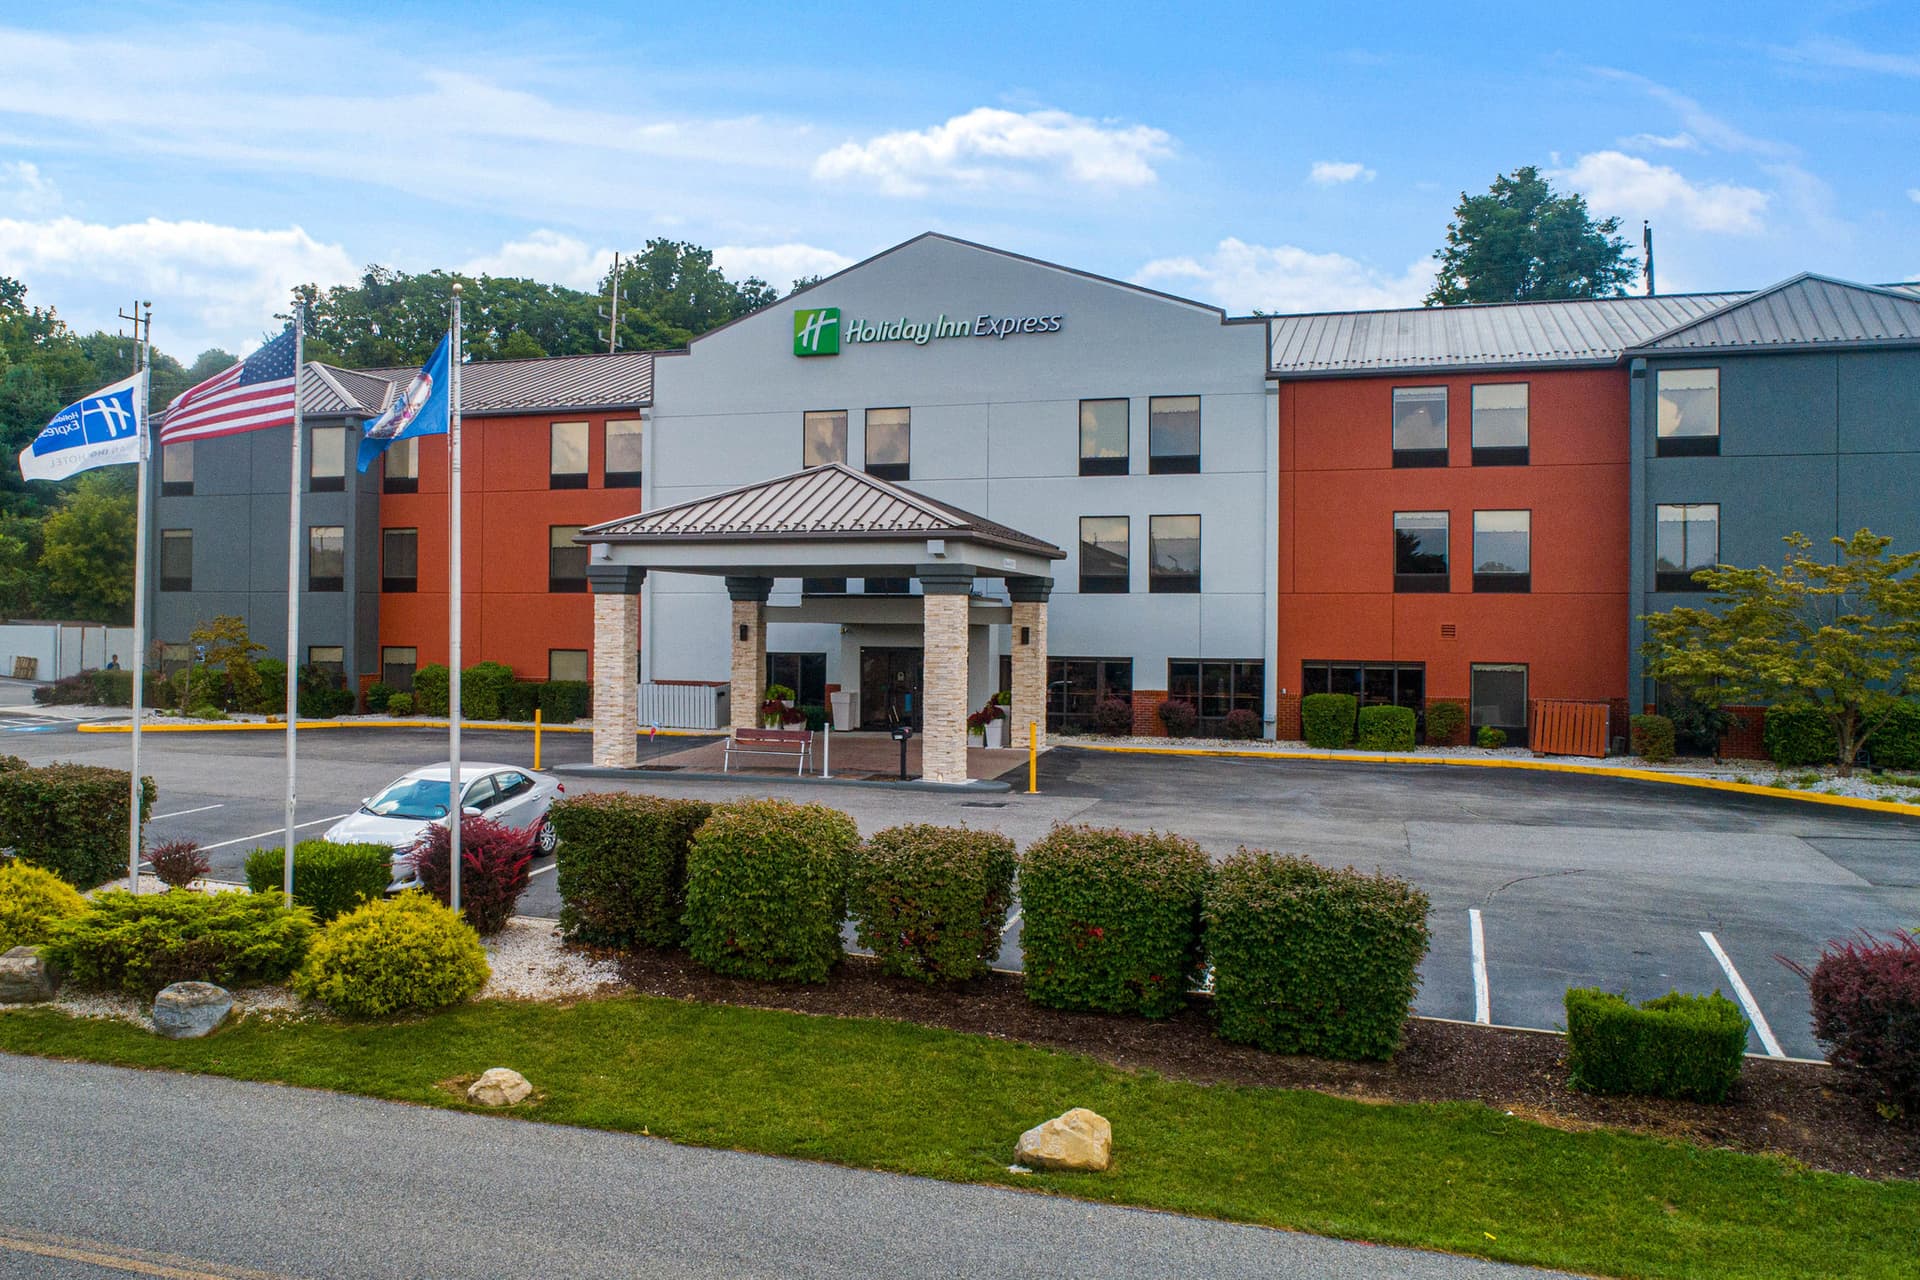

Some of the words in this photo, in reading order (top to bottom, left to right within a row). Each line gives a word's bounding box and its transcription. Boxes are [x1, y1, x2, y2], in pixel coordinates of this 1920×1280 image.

[845, 317, 931, 345] Holiday
[934, 313, 970, 339] Inn
[974, 312, 1062, 340] Express
